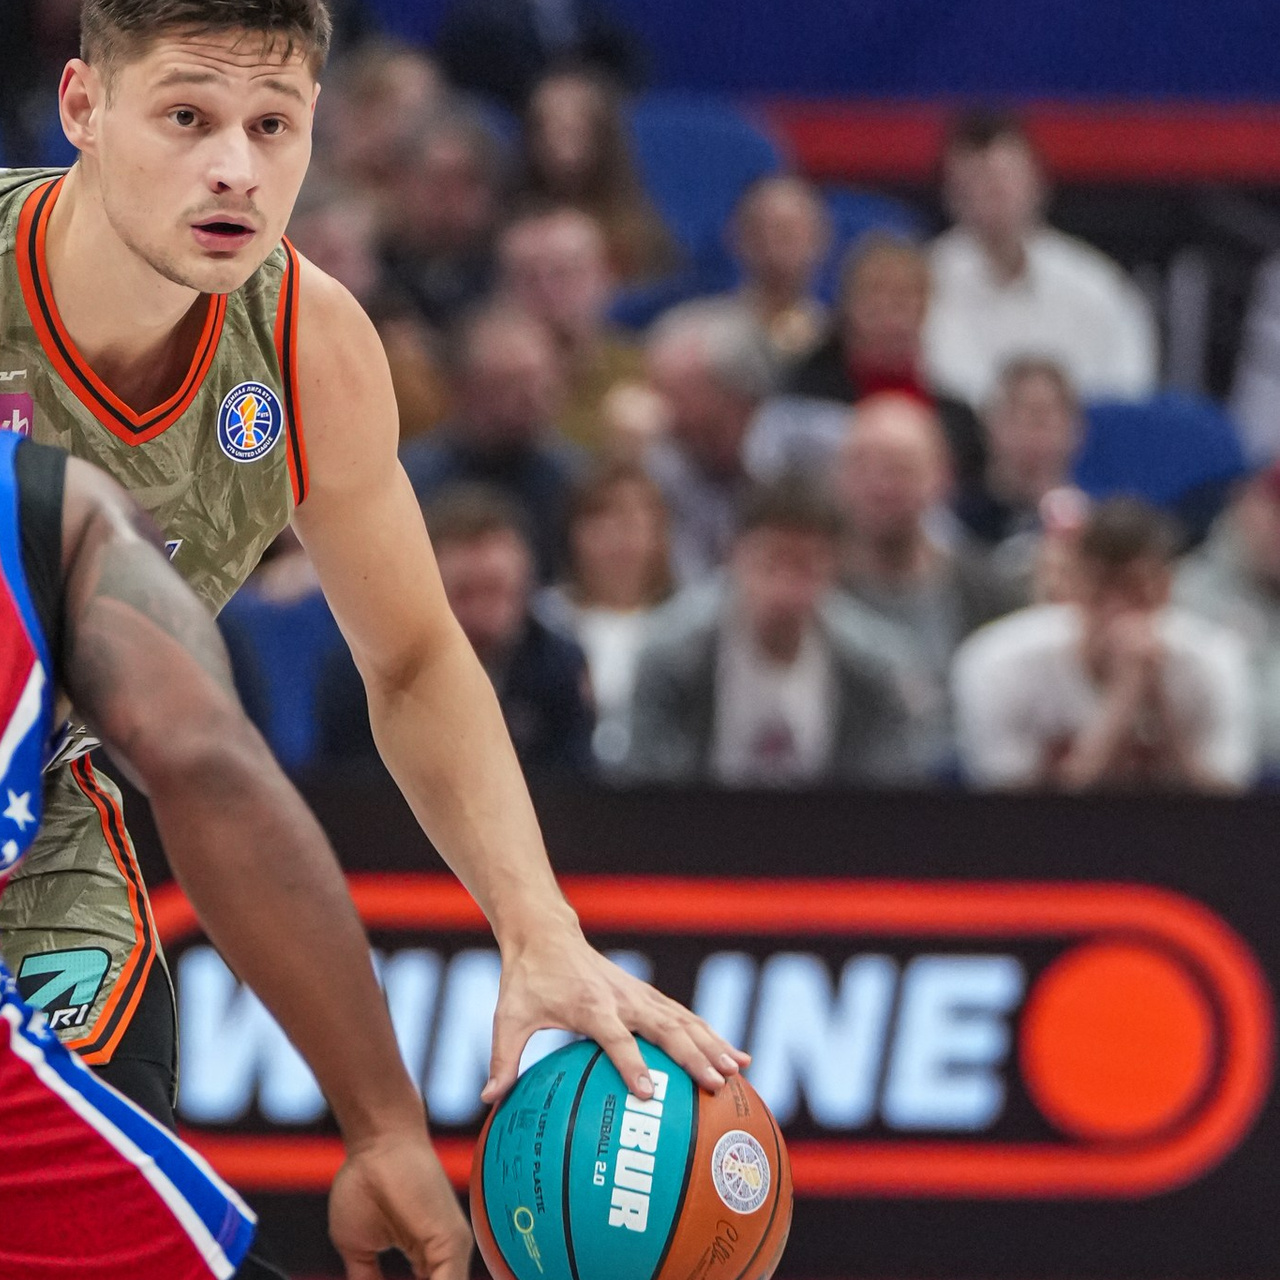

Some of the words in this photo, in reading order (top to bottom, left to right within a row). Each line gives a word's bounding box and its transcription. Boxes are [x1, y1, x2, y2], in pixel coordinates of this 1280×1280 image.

[255, 436, 274, 455] LEAGUE
[535, 1112, 549, 1138] LIFE
[534, 1142, 542, 1157] OF
[533, 1161, 546, 1214] PLASTIC
